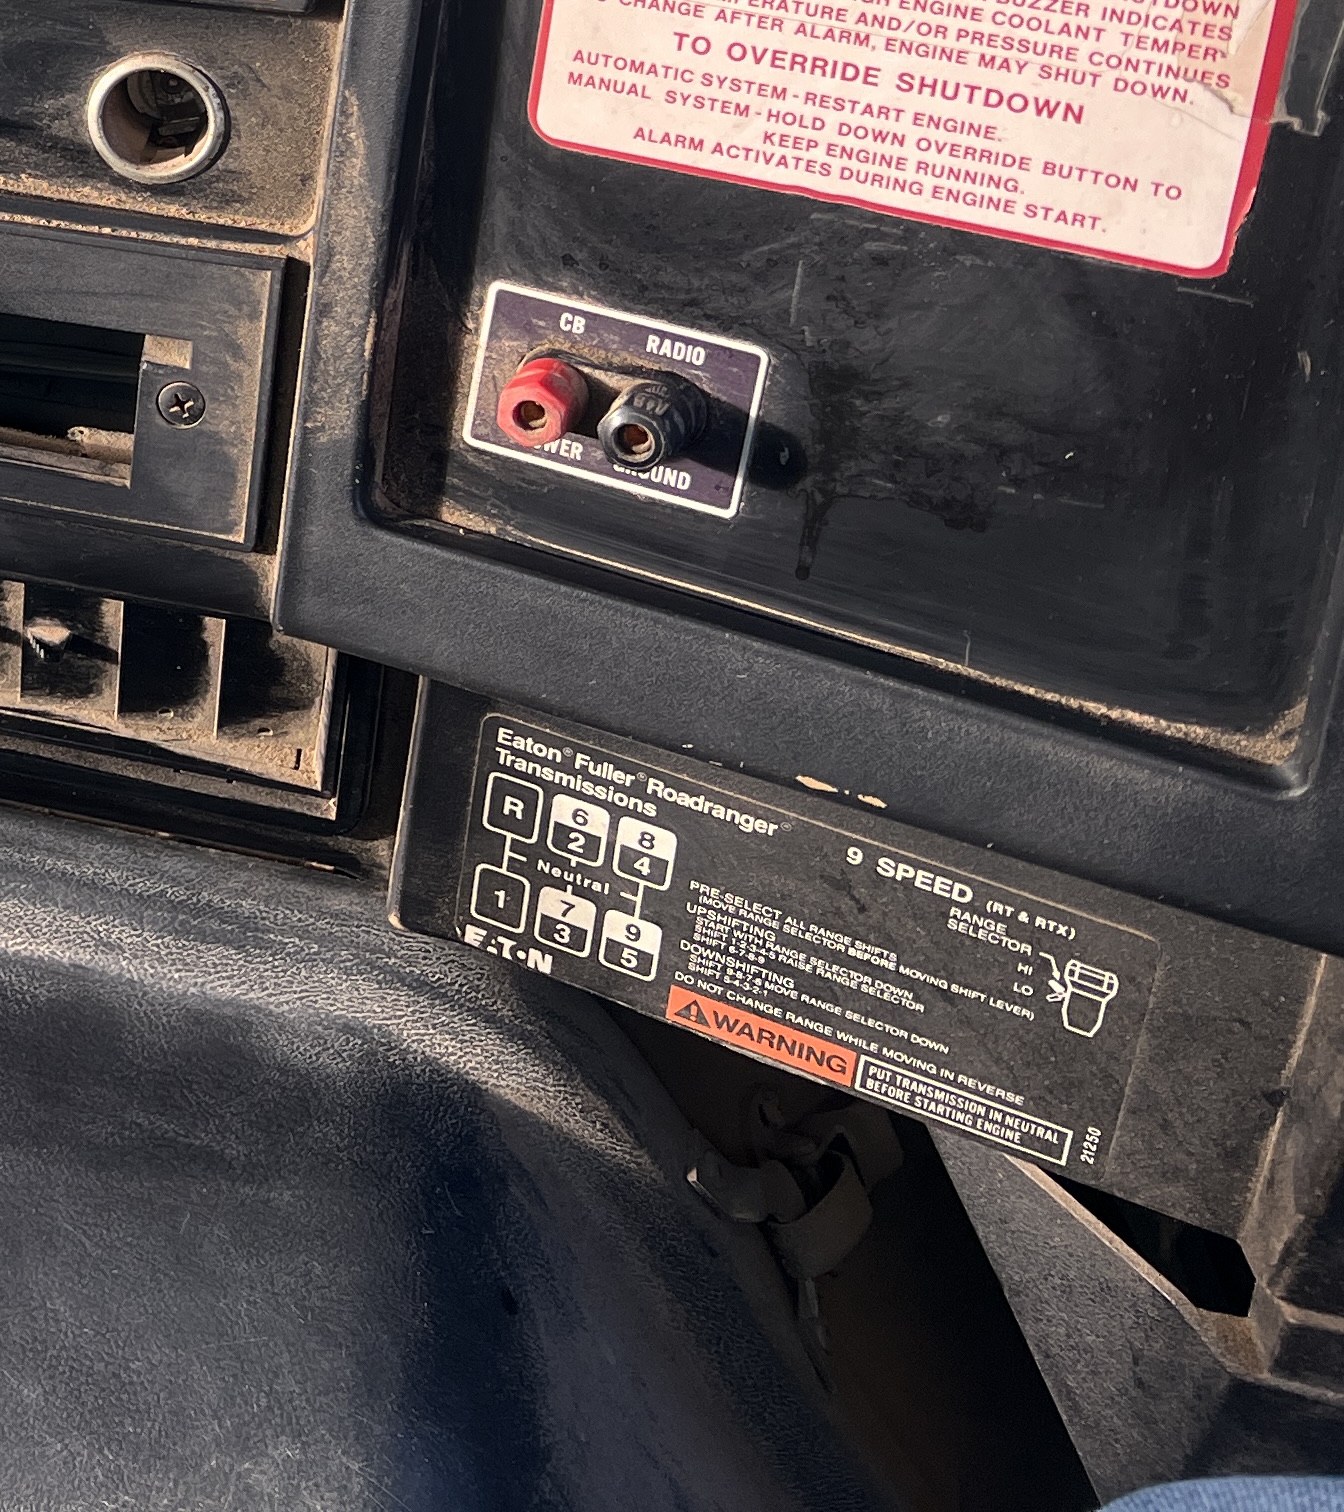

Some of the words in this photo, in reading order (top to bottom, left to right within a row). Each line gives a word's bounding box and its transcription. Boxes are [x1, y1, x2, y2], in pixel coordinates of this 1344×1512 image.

[673, 31, 711, 55] TO
[726, 42, 881, 87] OVERRIDE
[895, 72, 1084, 124] SHUTDOWN
[633, 126, 704, 152] ALARM
[710, 141, 832, 177] ACTIVATES
[839, 166, 923, 196] DURING
[931, 185, 1016, 214] ENGINE
[1023, 203, 1105, 232] START.
[762, 130, 819, 152] KEEP
[825, 142, 908, 171] ENGINE
[915, 160, 1024, 194] RUNNING.
[559, 312, 586, 335] CB
[646, 335, 706, 366] RADIO
[533, 439, 584, 461] WER
[495, 746, 657, 817] Transmissions
[503, 795, 524, 820] R
[571, 807, 588, 826] 6
[567, 831, 585, 853] 2
[637, 831, 655, 850] 8
[536, 859, 609, 895] Neutral
[633, 856, 650, 876] 4
[846, 846, 863, 865] 9
[876, 856, 973, 903] SPEED
[494, 889, 505, 908] 1
[560, 899, 575, 917] 7
[689, 880, 782, 919] PRE-SELECT
[553, 923, 570, 943] 3
[624, 923, 641, 942] 9
[686, 901, 776, 942] UPSHIFTING
[946, 918, 1032, 956] SELECTOR
[949, 906, 1007, 935] RANGE
[986, 900, 1014, 917] (RT
[1017, 911, 1029, 923] &
[1034, 915, 1075, 940] RTX)
[620, 947, 638, 968] 5
[680, 939, 794, 989] DOWNSHIFTING
[1017, 962, 1033, 975] HI
[1013, 981, 1033, 996] LO
[713, 1010, 847, 1075] WARNING
[865, 1077, 911, 1103] BEFORE
[913, 1095, 973, 1126] STARTING
[976, 1117, 1021, 1143] ENGINE
[868, 1065, 892, 1081] PUT
[895, 1074, 986, 1116] TRANSMISSION
[988, 1108, 1003, 1123] IN
[1004, 1114, 1058, 1144] NEUTRAL
[1080, 1126, 1101, 1164] 21250
